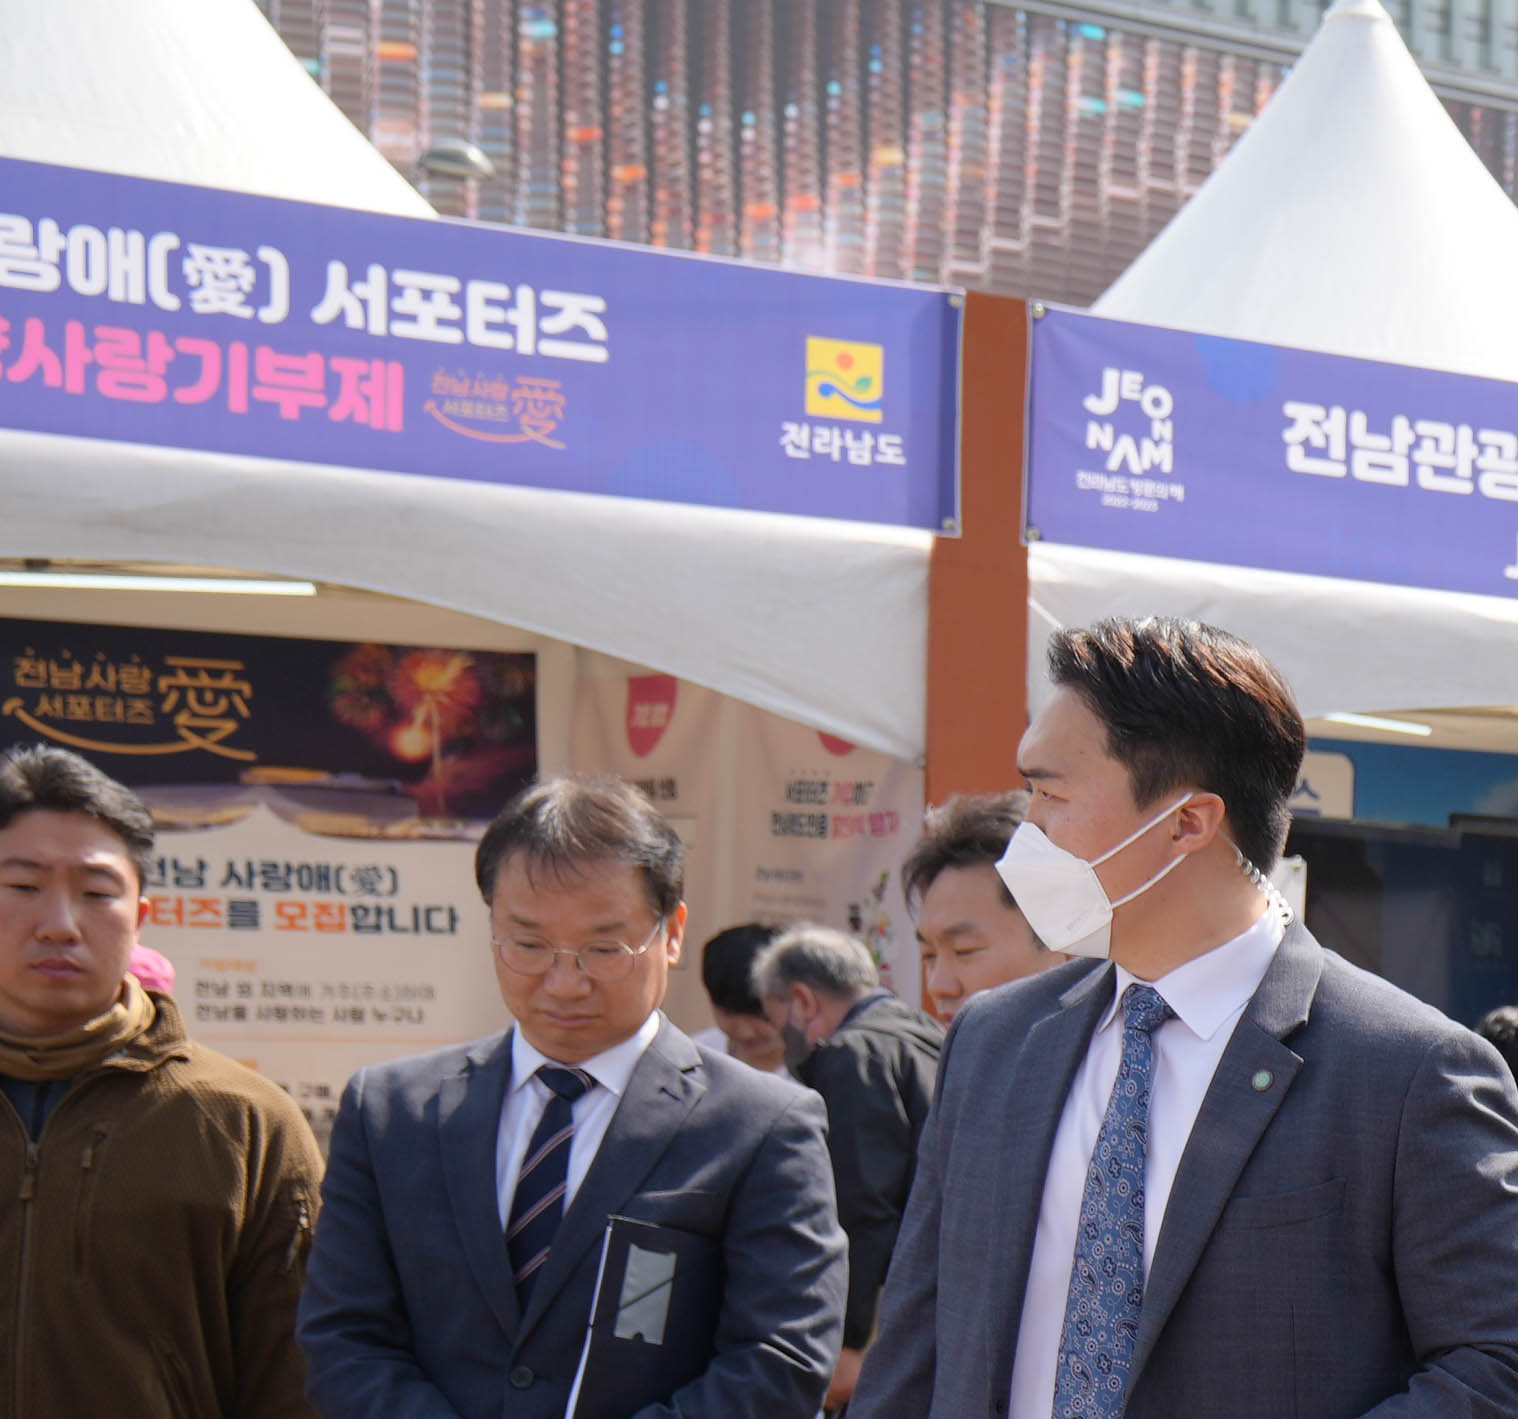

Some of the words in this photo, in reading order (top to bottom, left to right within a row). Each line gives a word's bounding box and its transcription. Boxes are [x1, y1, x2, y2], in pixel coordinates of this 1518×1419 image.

[310, 260, 609, 363] 서포터즈
[0, 316, 405, 432] 사랑기부제
[780, 421, 907, 466] 전라남도
[13, 652, 152, 694] 전남사랑
[34, 692, 155, 725] 서포터즈
[158, 656, 258, 761] 愛
[219, 858, 399, 896] 사랑애(愛)
[274, 899, 460, 935] 모집합니다
